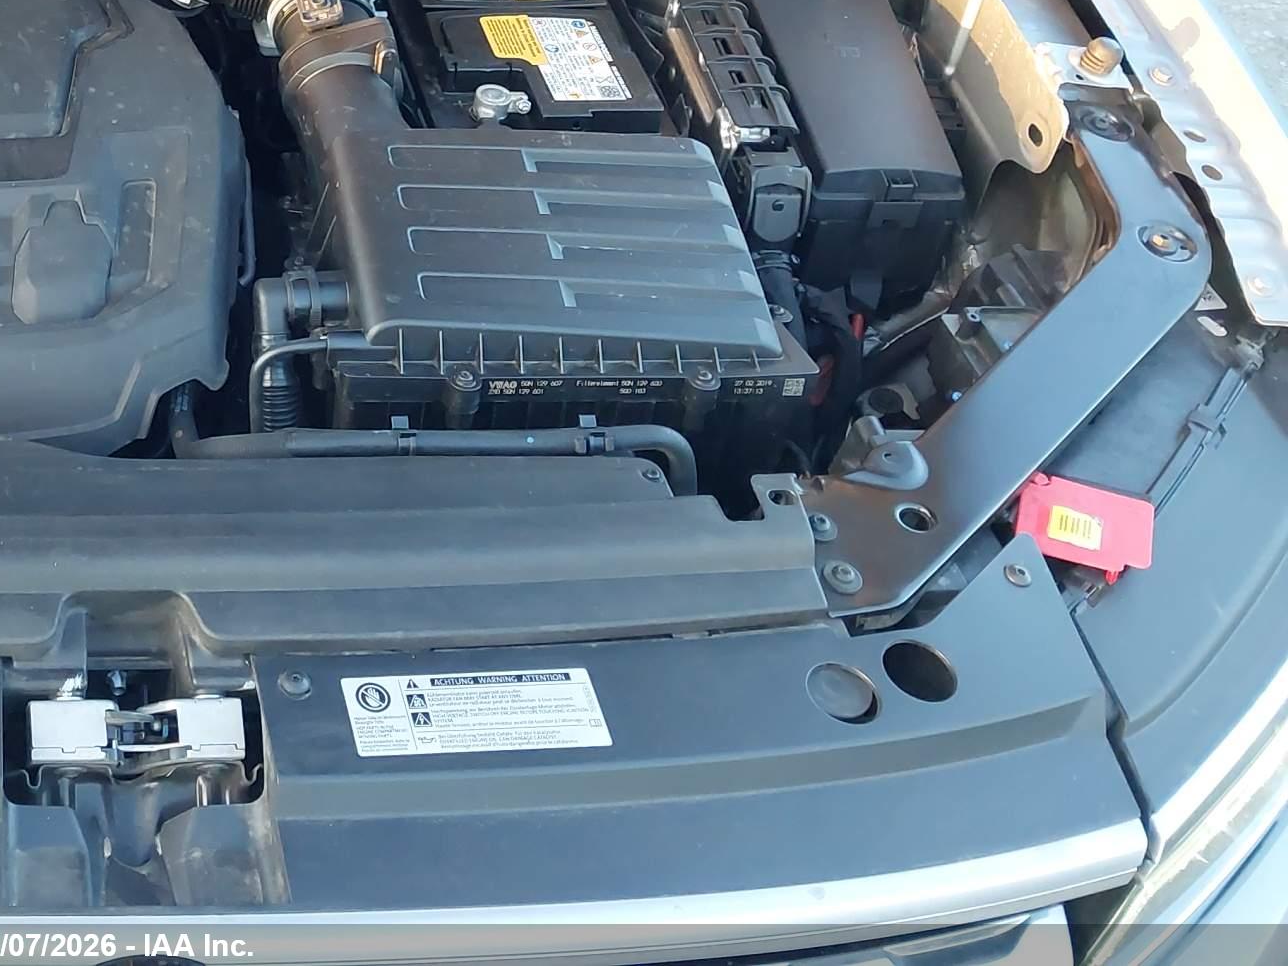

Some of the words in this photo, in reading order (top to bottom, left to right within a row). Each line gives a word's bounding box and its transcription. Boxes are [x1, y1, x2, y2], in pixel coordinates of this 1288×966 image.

[434, 677, 474, 686] ACHTUNG
[477, 675, 519, 684] WARNING
[521, 673, 566, 682] ATTENTION
